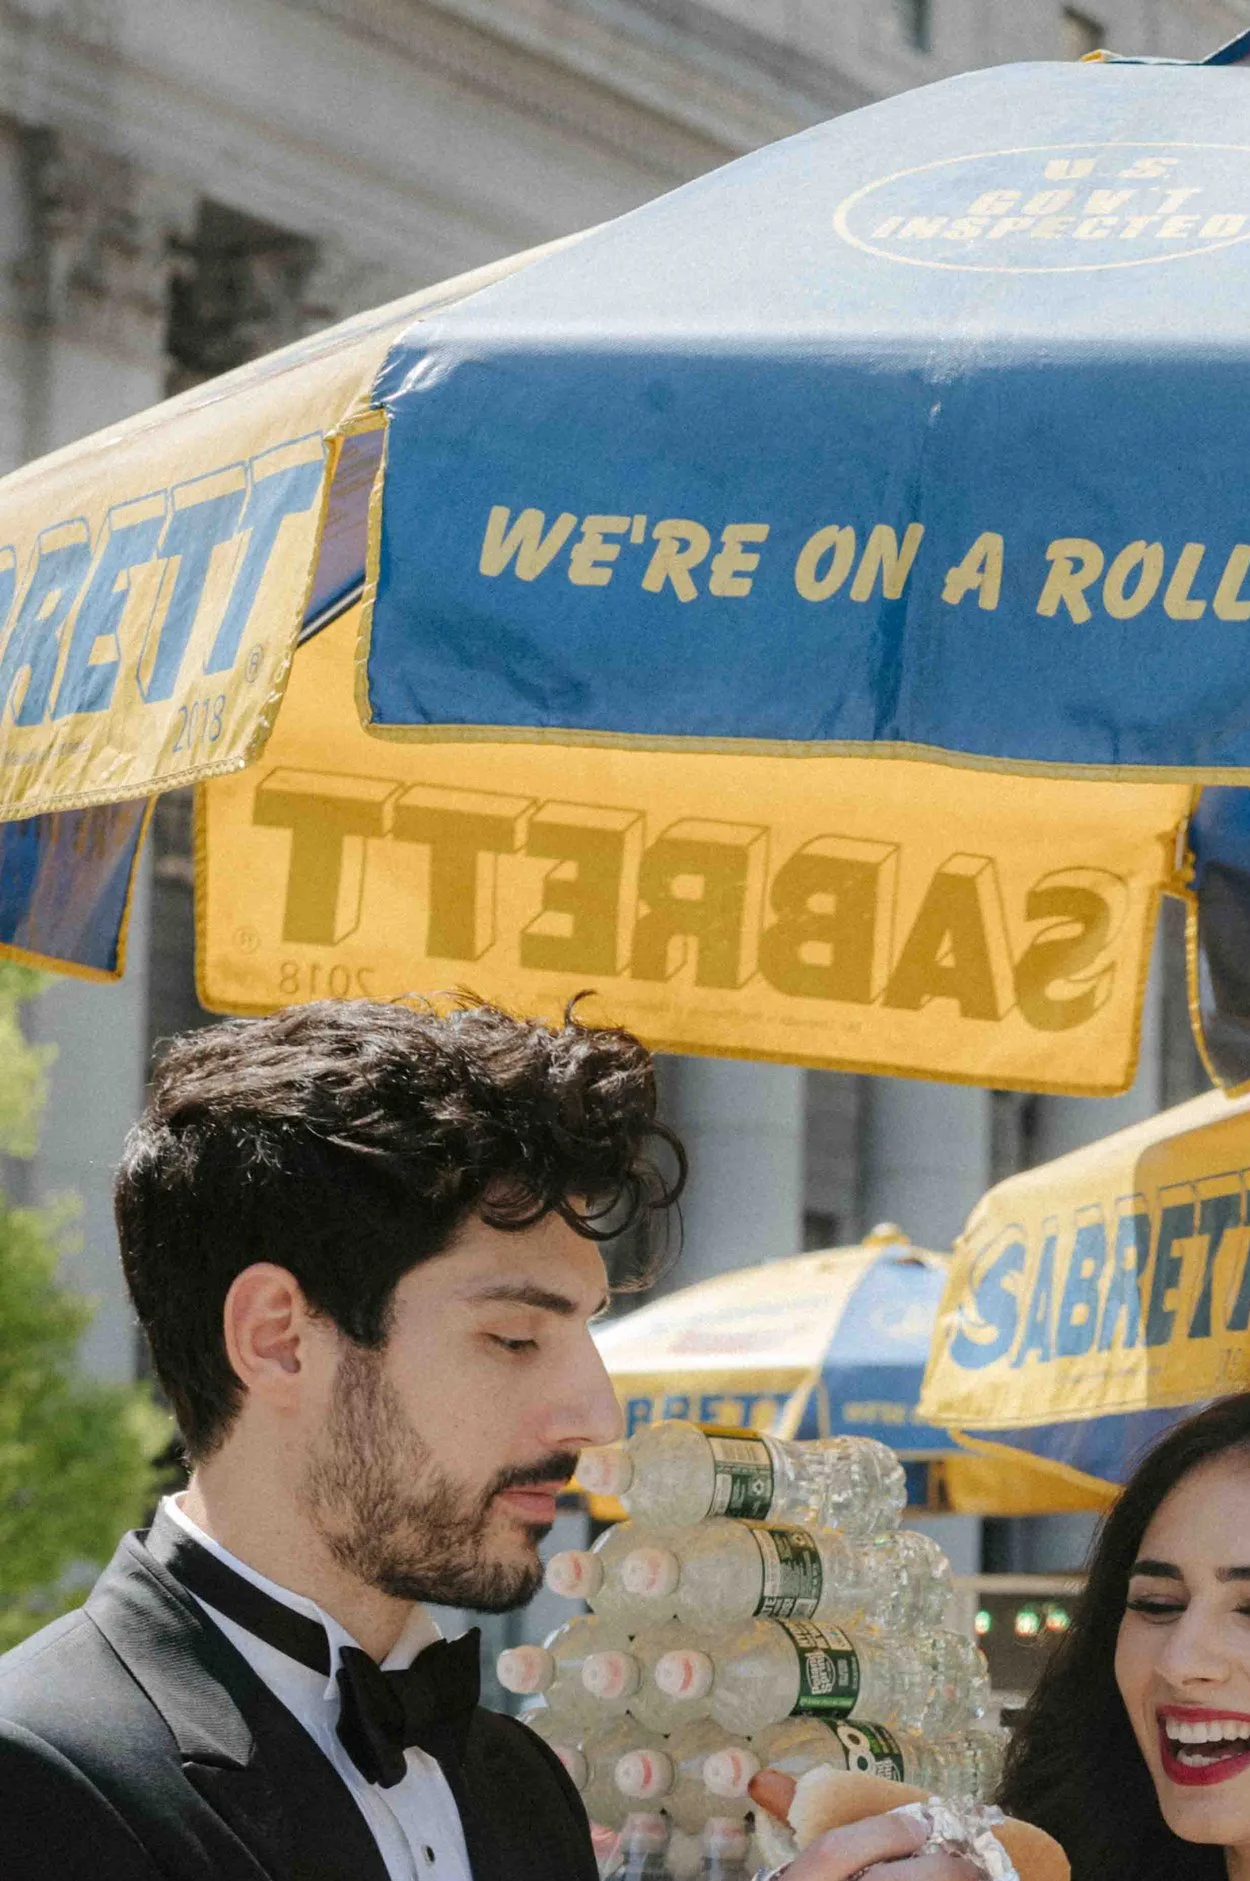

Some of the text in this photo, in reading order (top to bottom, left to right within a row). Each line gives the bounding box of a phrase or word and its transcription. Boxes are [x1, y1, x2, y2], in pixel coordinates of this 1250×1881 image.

[0, 430, 325, 728] RETT
[478, 504, 771, 603] WE'RE
[794, 523, 925, 603] ON
[941, 531, 1005, 611] A
